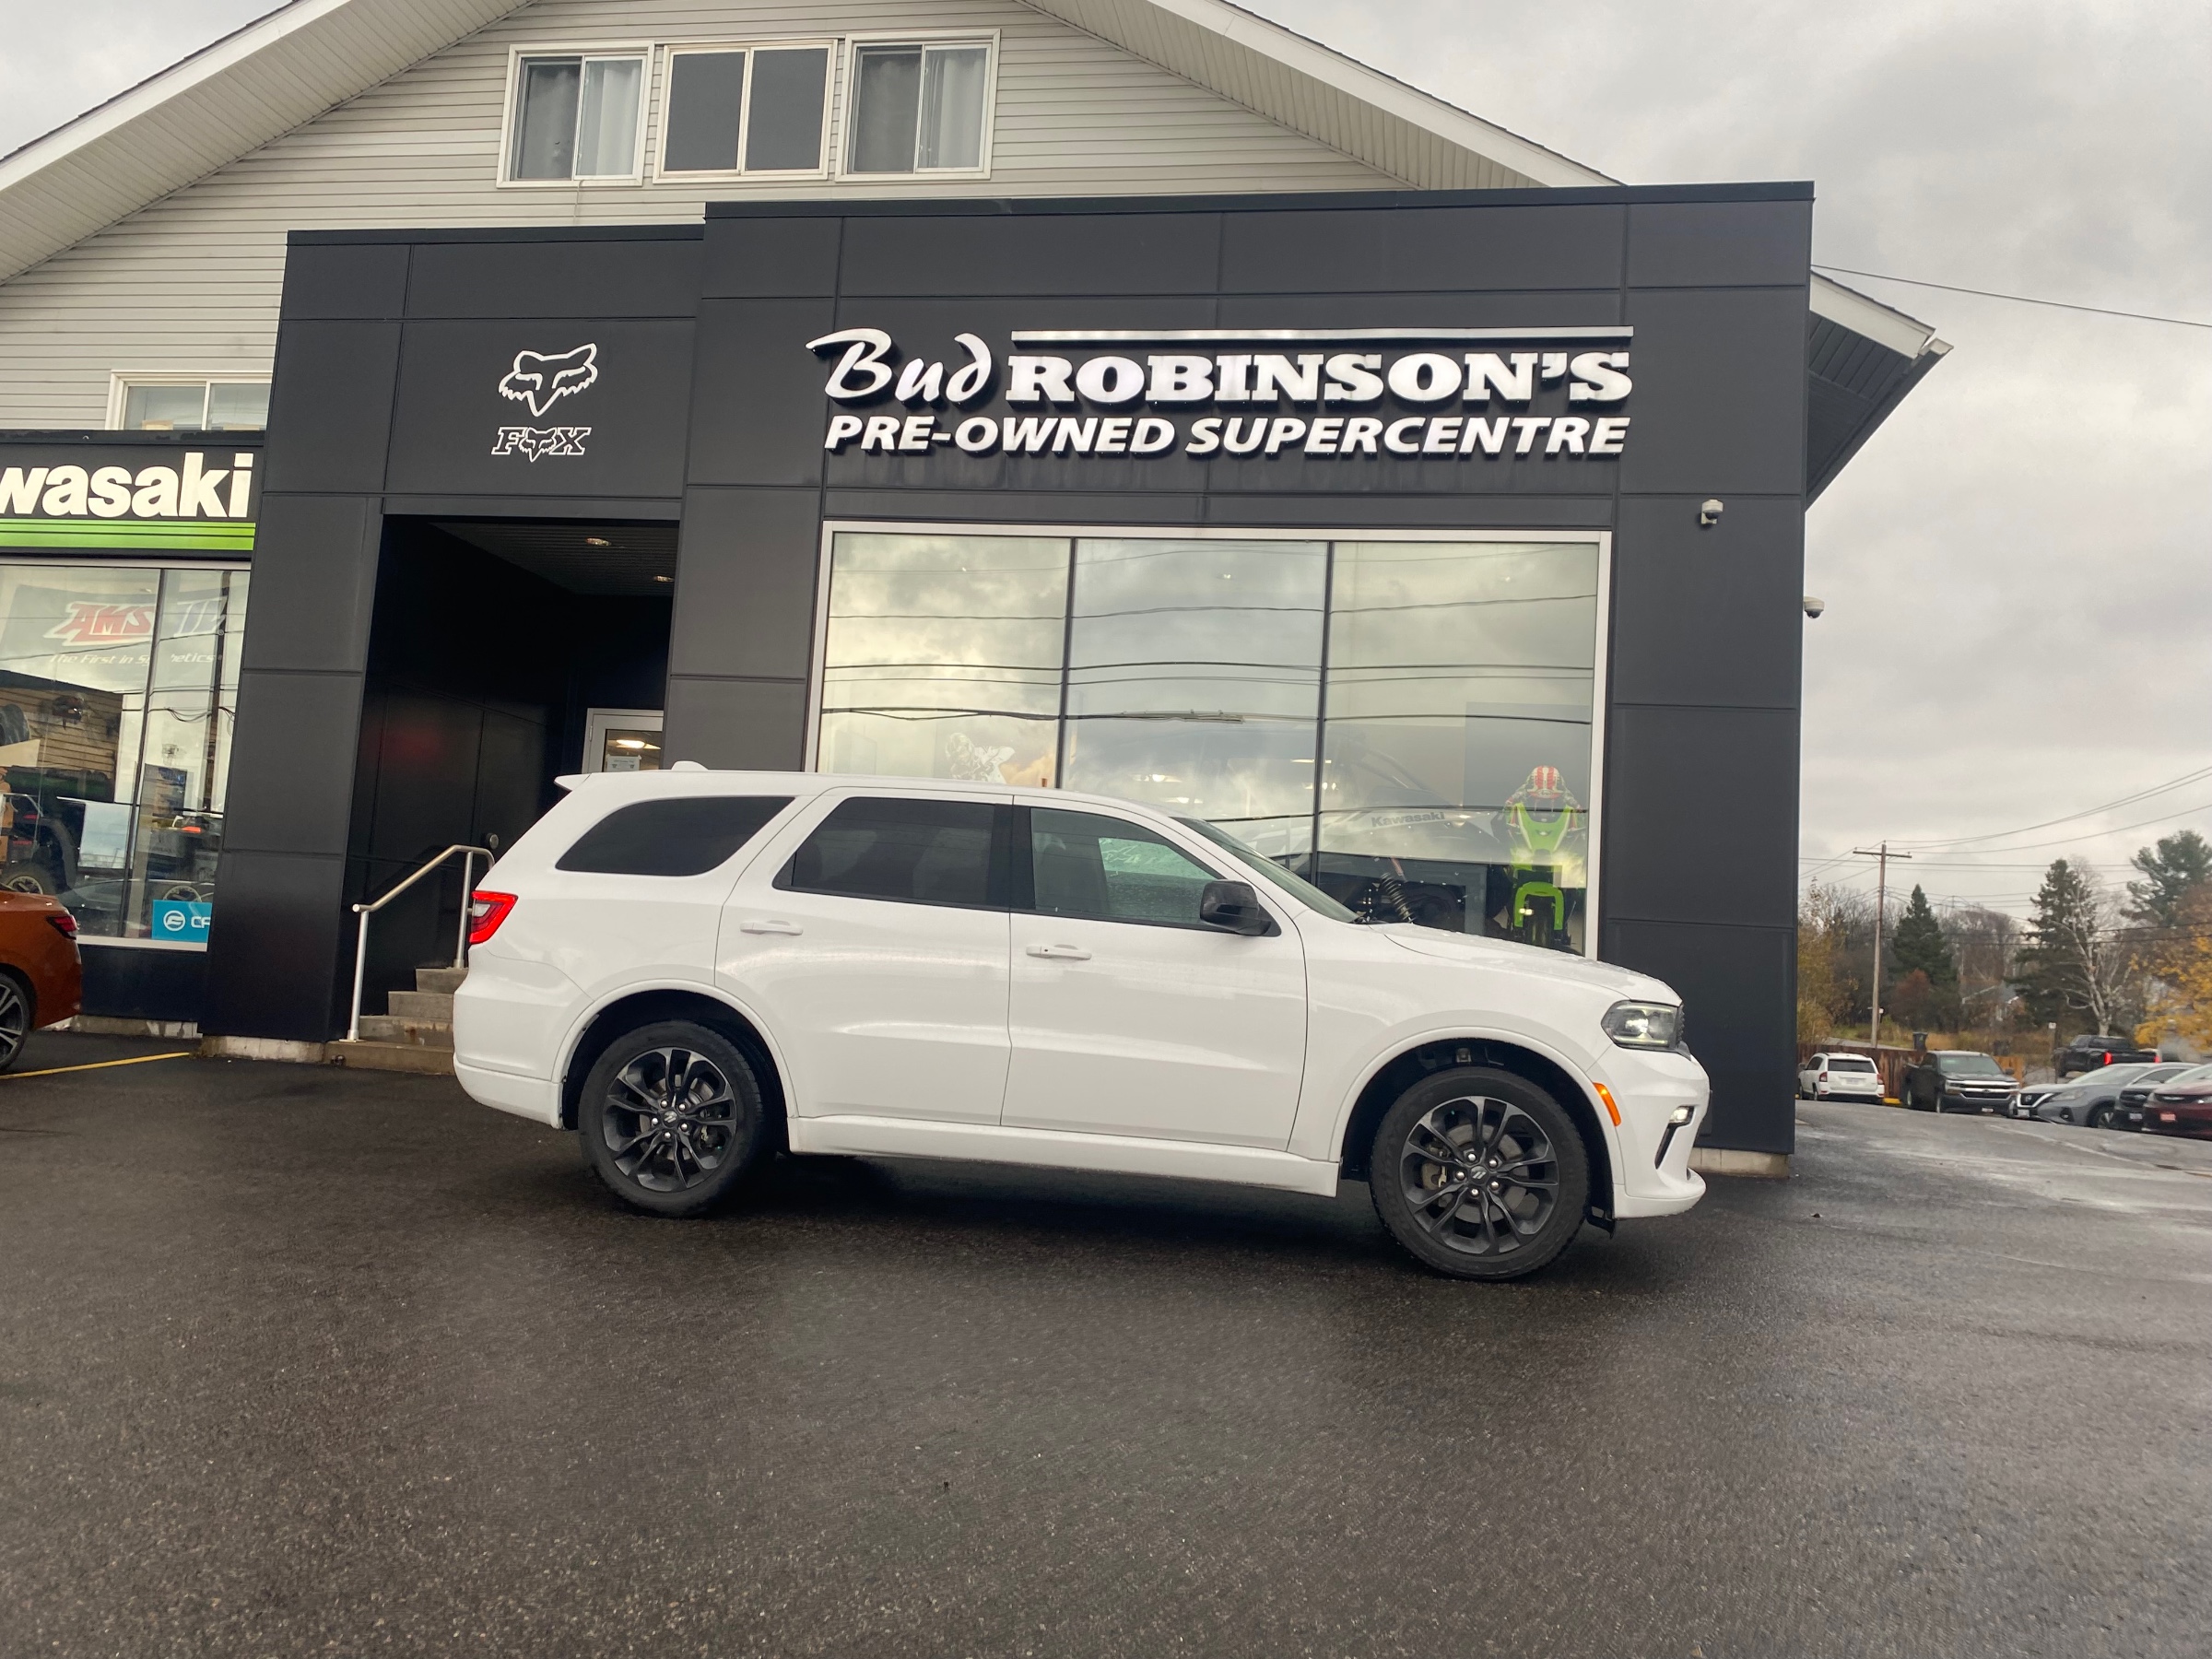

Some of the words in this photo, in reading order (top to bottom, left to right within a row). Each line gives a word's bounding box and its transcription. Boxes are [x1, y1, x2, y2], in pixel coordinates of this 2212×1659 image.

[805, 328, 992, 403] Bud
[1006, 351, 1633, 403] ROBINSON'S
[824, 415, 1175, 453] PRE-OWNED
[1184, 416, 1630, 454] SUPERCENTRE
[80, 653, 117, 665] First
[119, 654, 135, 665] in
[1371, 811, 1446, 828] Kawasaki
